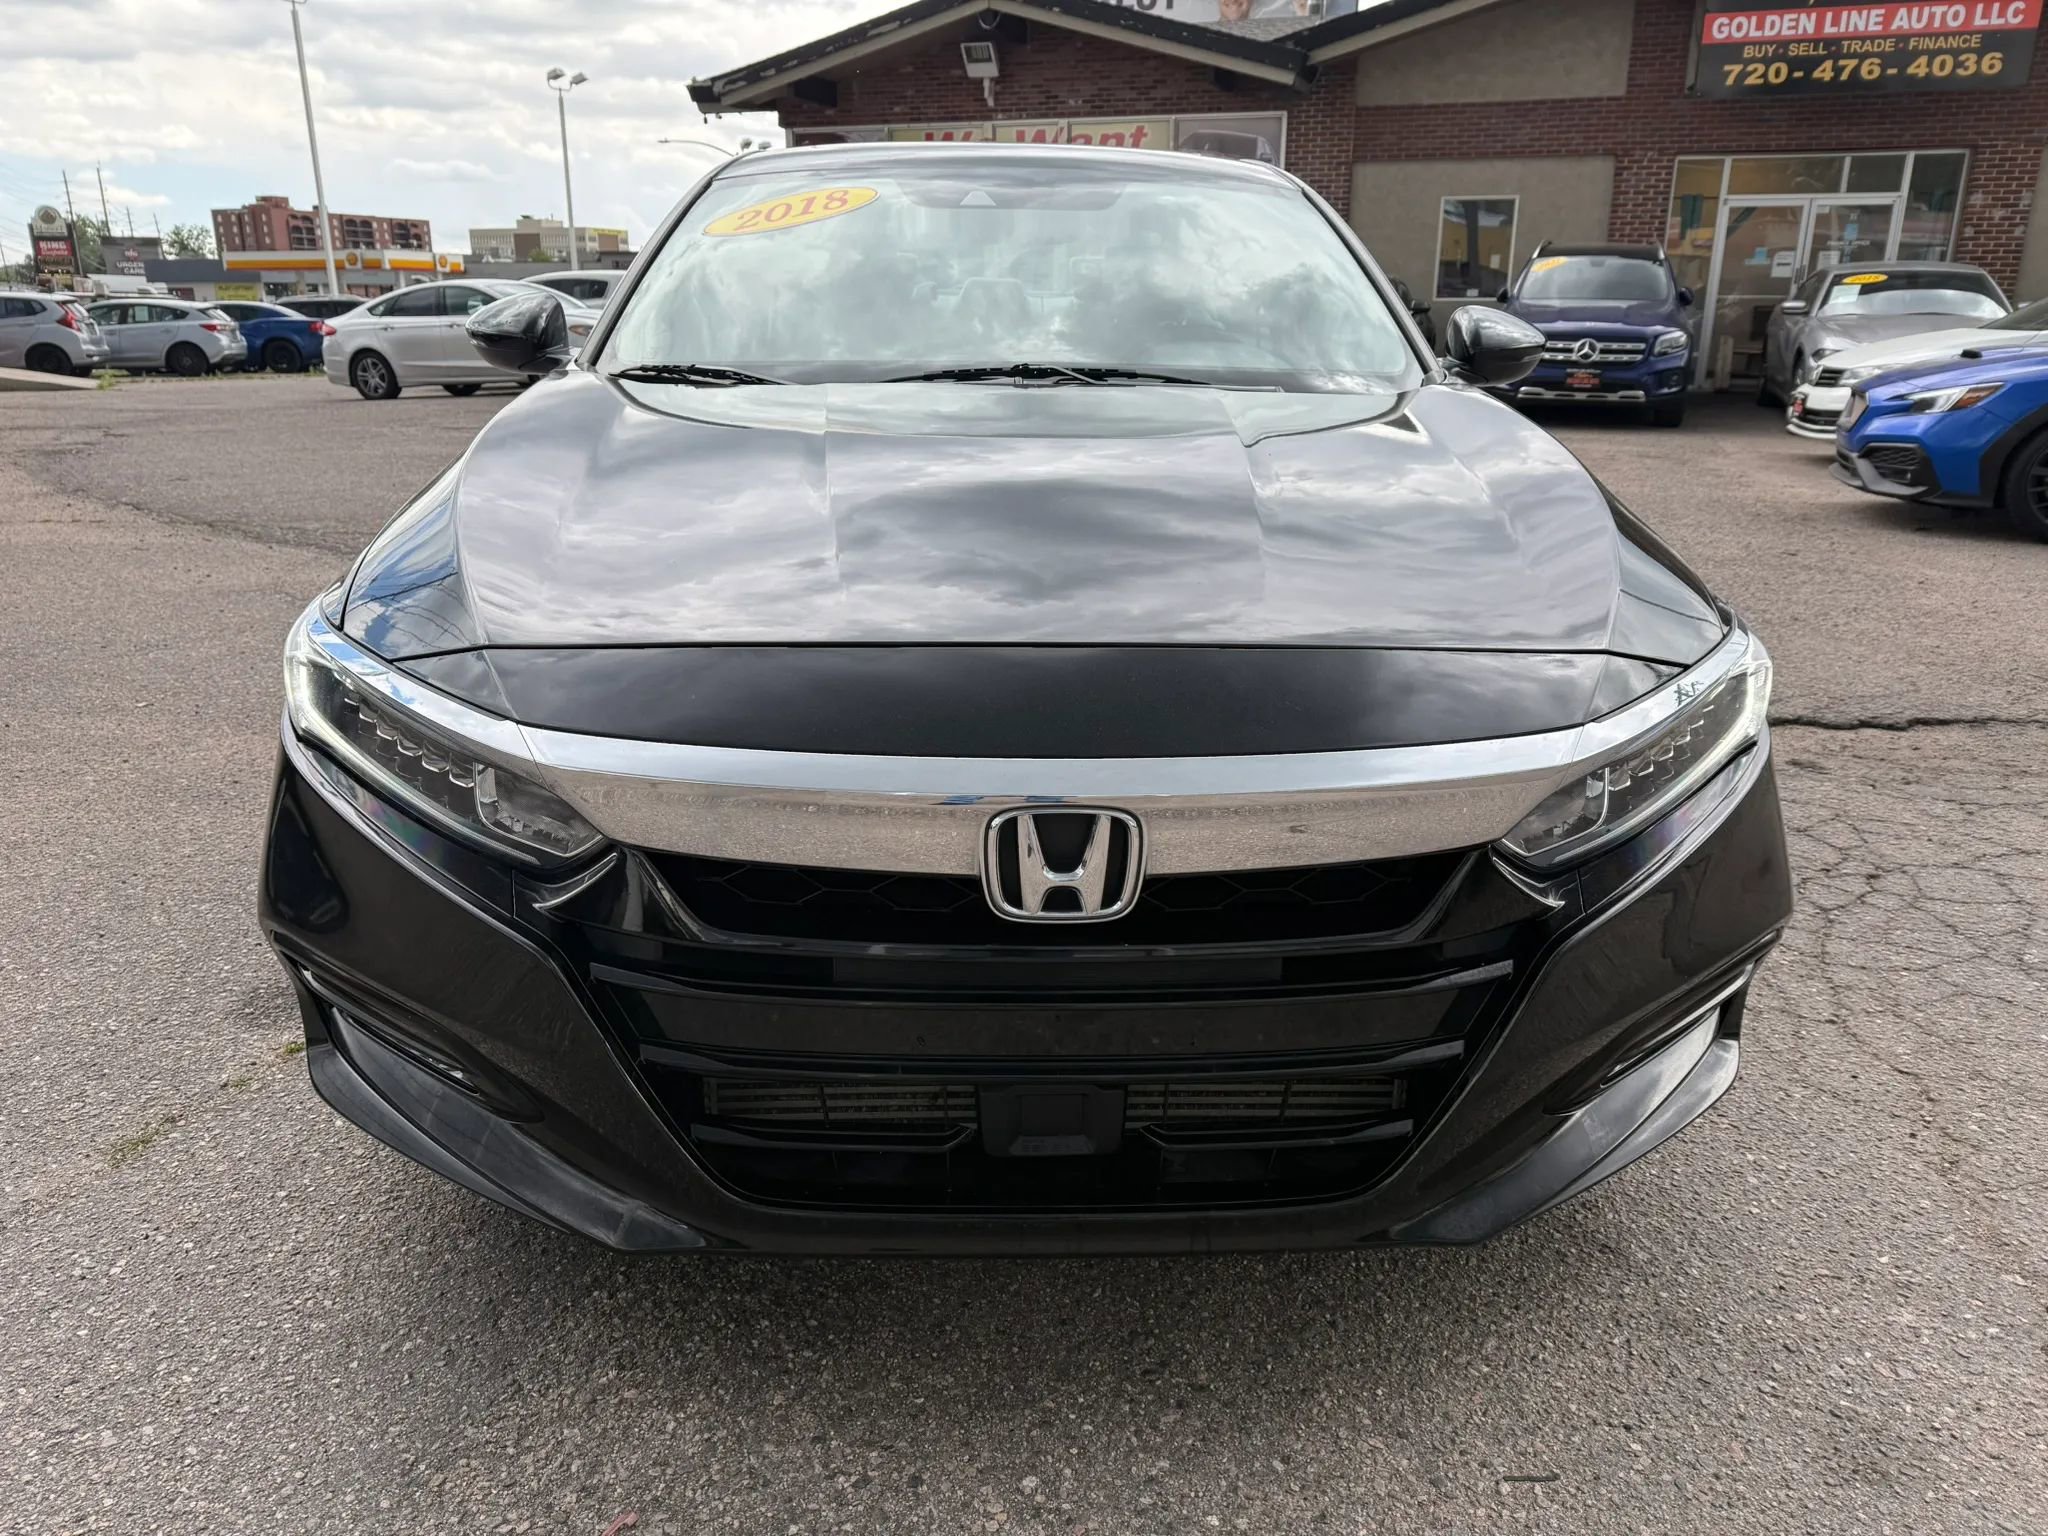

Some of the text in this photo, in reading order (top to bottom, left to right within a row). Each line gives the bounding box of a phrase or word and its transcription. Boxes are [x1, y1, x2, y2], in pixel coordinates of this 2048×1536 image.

[1711, 0, 2027, 40] GOLDEN LINE AUTO LLC
[1743, 33, 1983, 58] BUY SELL TRADE FINANCE
[734, 189, 850, 232] 2018
